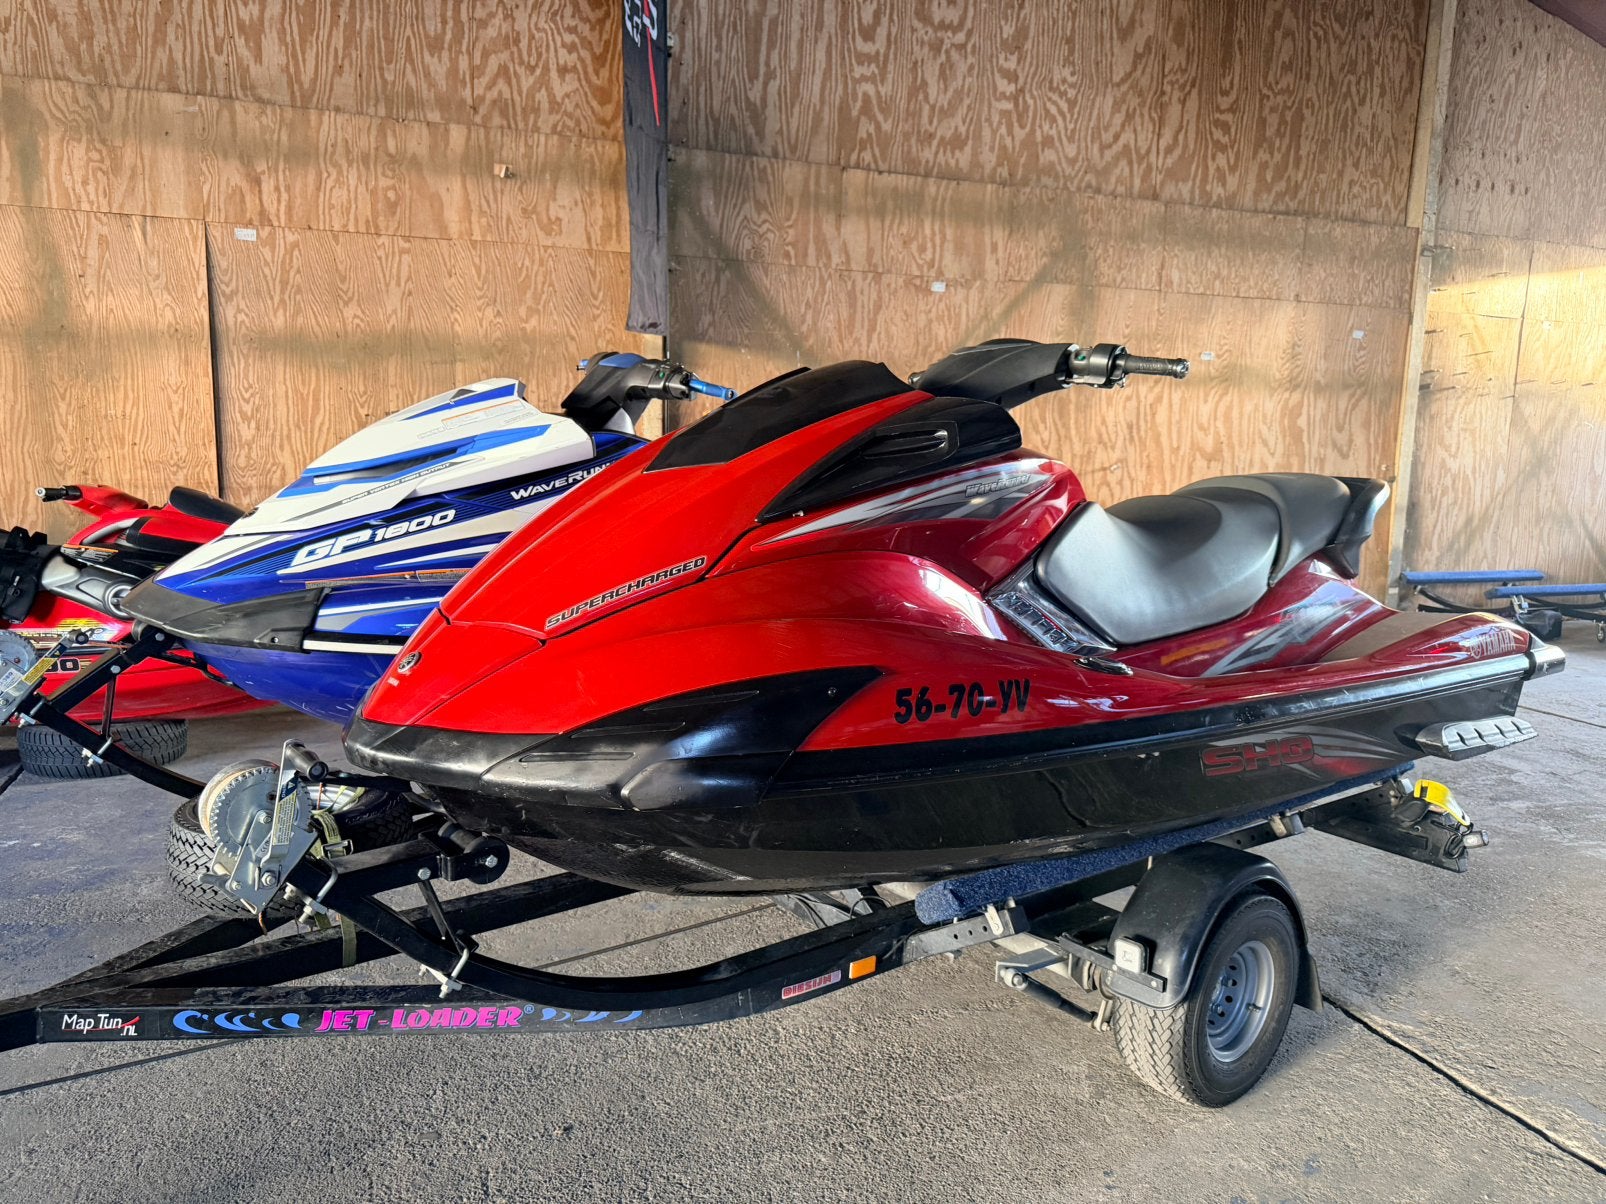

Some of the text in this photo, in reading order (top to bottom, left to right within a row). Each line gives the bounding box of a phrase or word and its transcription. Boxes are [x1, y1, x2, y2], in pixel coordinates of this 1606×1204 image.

[510, 462, 612, 500] WAVERUN
[545, 556, 706, 630] SUPERCHARGED
[1480, 629, 1516, 656] YAMAHA
[894, 678, 1031, 724] 56-70-YV
[1202, 735, 1314, 777] SHO
[62, 1014, 94, 1034] Map
[97, 1013, 122, 1029] Tun
